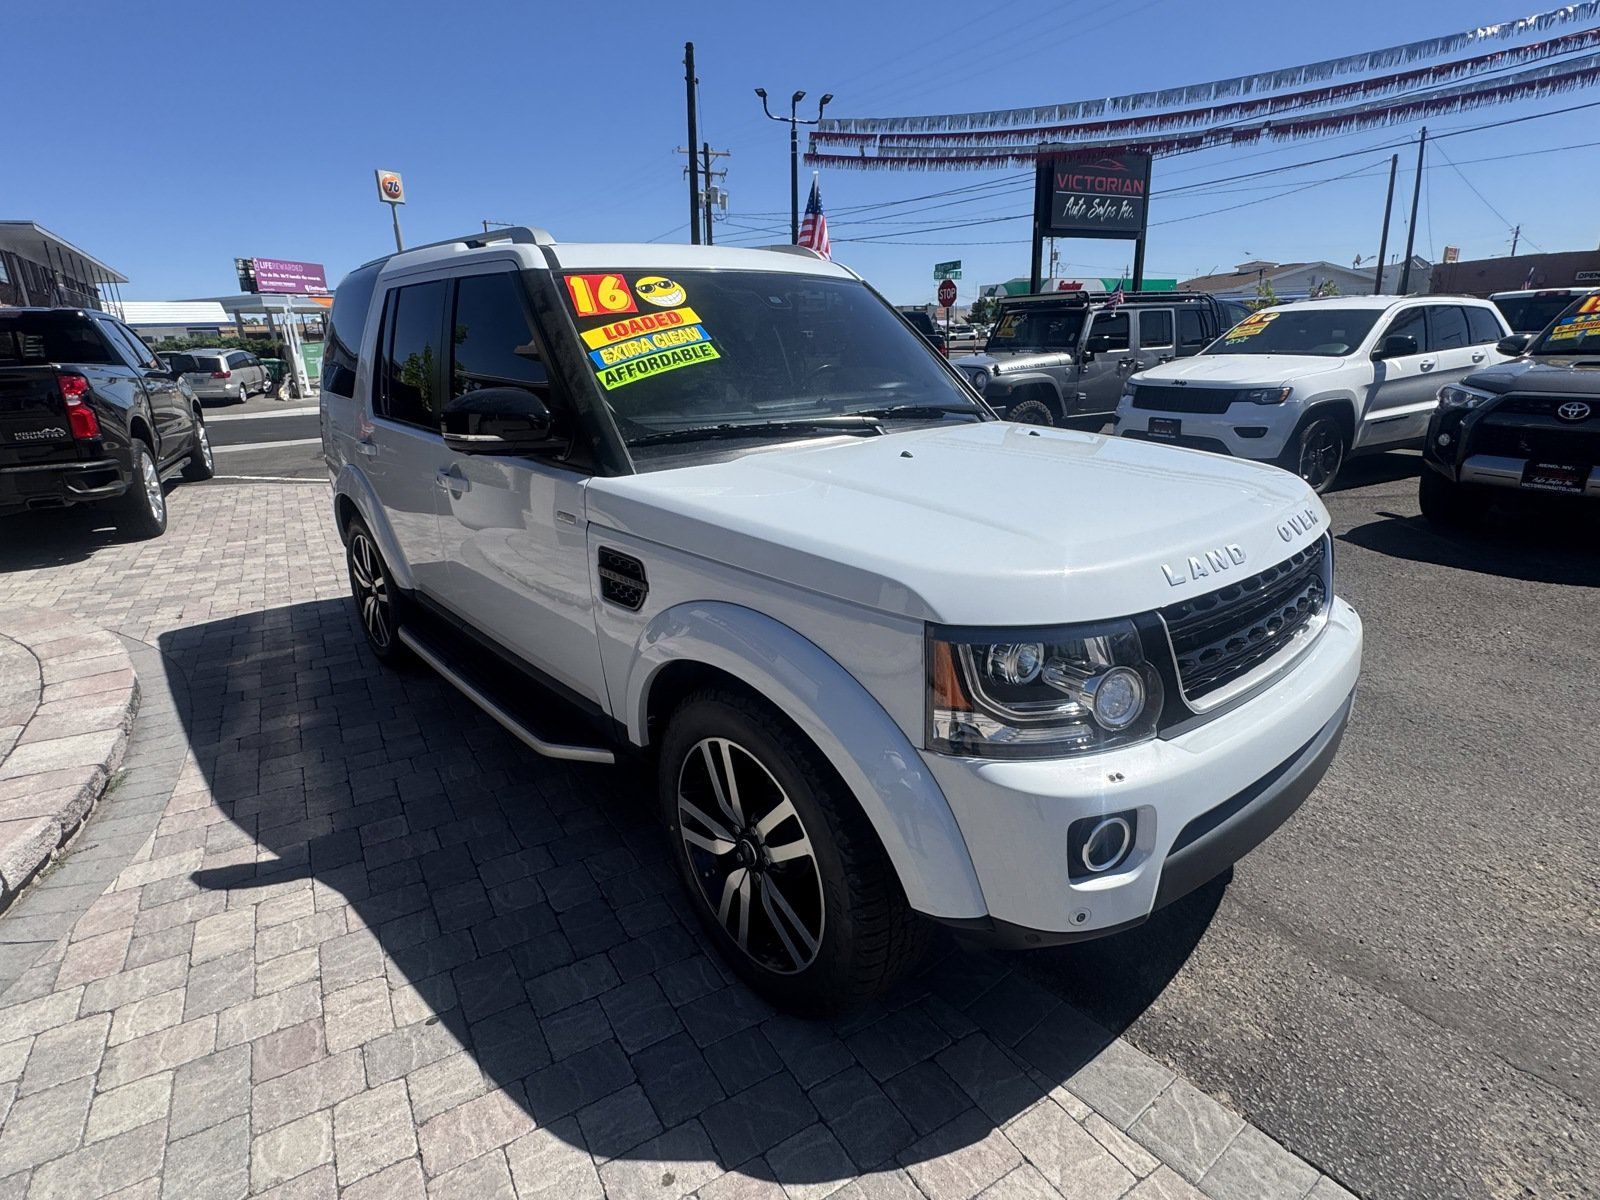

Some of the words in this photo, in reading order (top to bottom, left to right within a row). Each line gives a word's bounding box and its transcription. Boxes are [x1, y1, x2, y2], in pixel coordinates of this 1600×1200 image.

[387, 181, 400, 192] 76
[1057, 174, 1144, 193] VICTORIAN
[569, 275, 631, 314] 16
[939, 287, 956, 299] STOP
[602, 310, 684, 341] LOADED
[600, 337, 657, 365] EXTRA
[652, 326, 703, 349] CLEAN
[604, 344, 713, 386] AFFORDABLE
[1161, 543, 1247, 586] LAND
[1277, 509, 1318, 542] OVER
